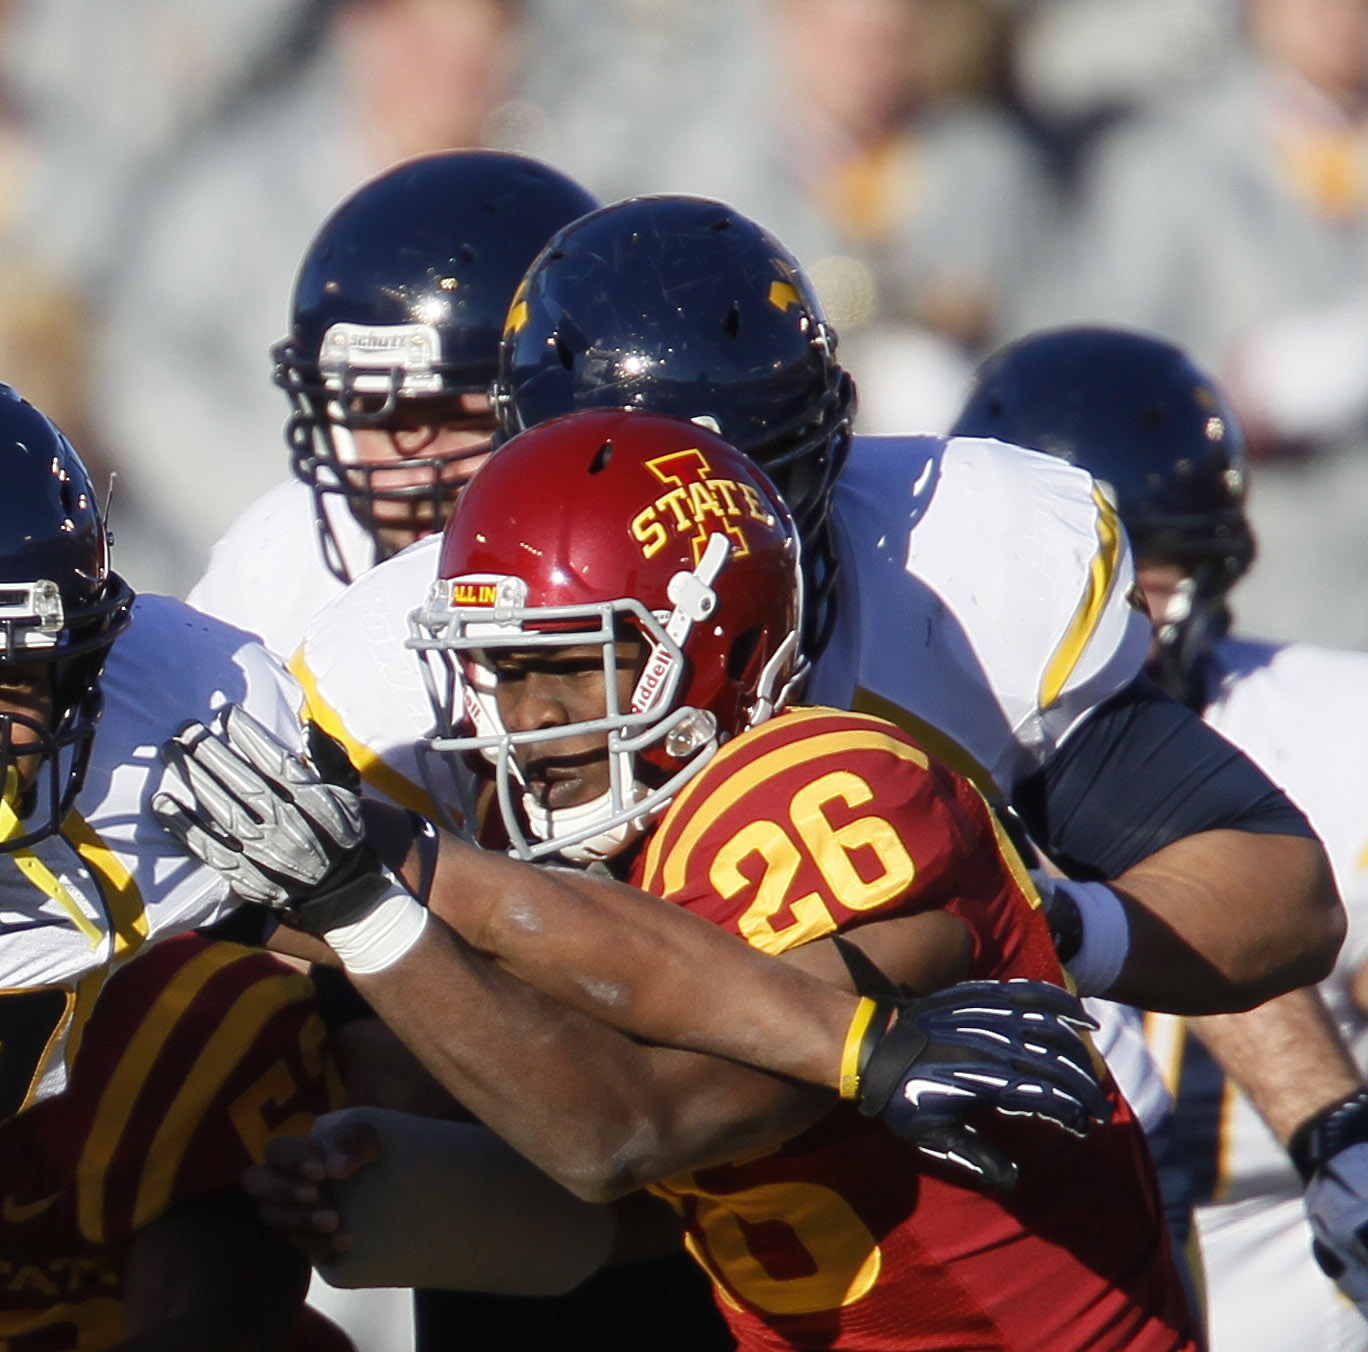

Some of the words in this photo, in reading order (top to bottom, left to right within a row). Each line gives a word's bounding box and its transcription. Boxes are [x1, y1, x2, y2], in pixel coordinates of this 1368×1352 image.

[630, 479, 776, 560] STATE
[452, 585, 477, 604] ALL
[479, 585, 496, 603] IN
[709, 770, 916, 957] 26
